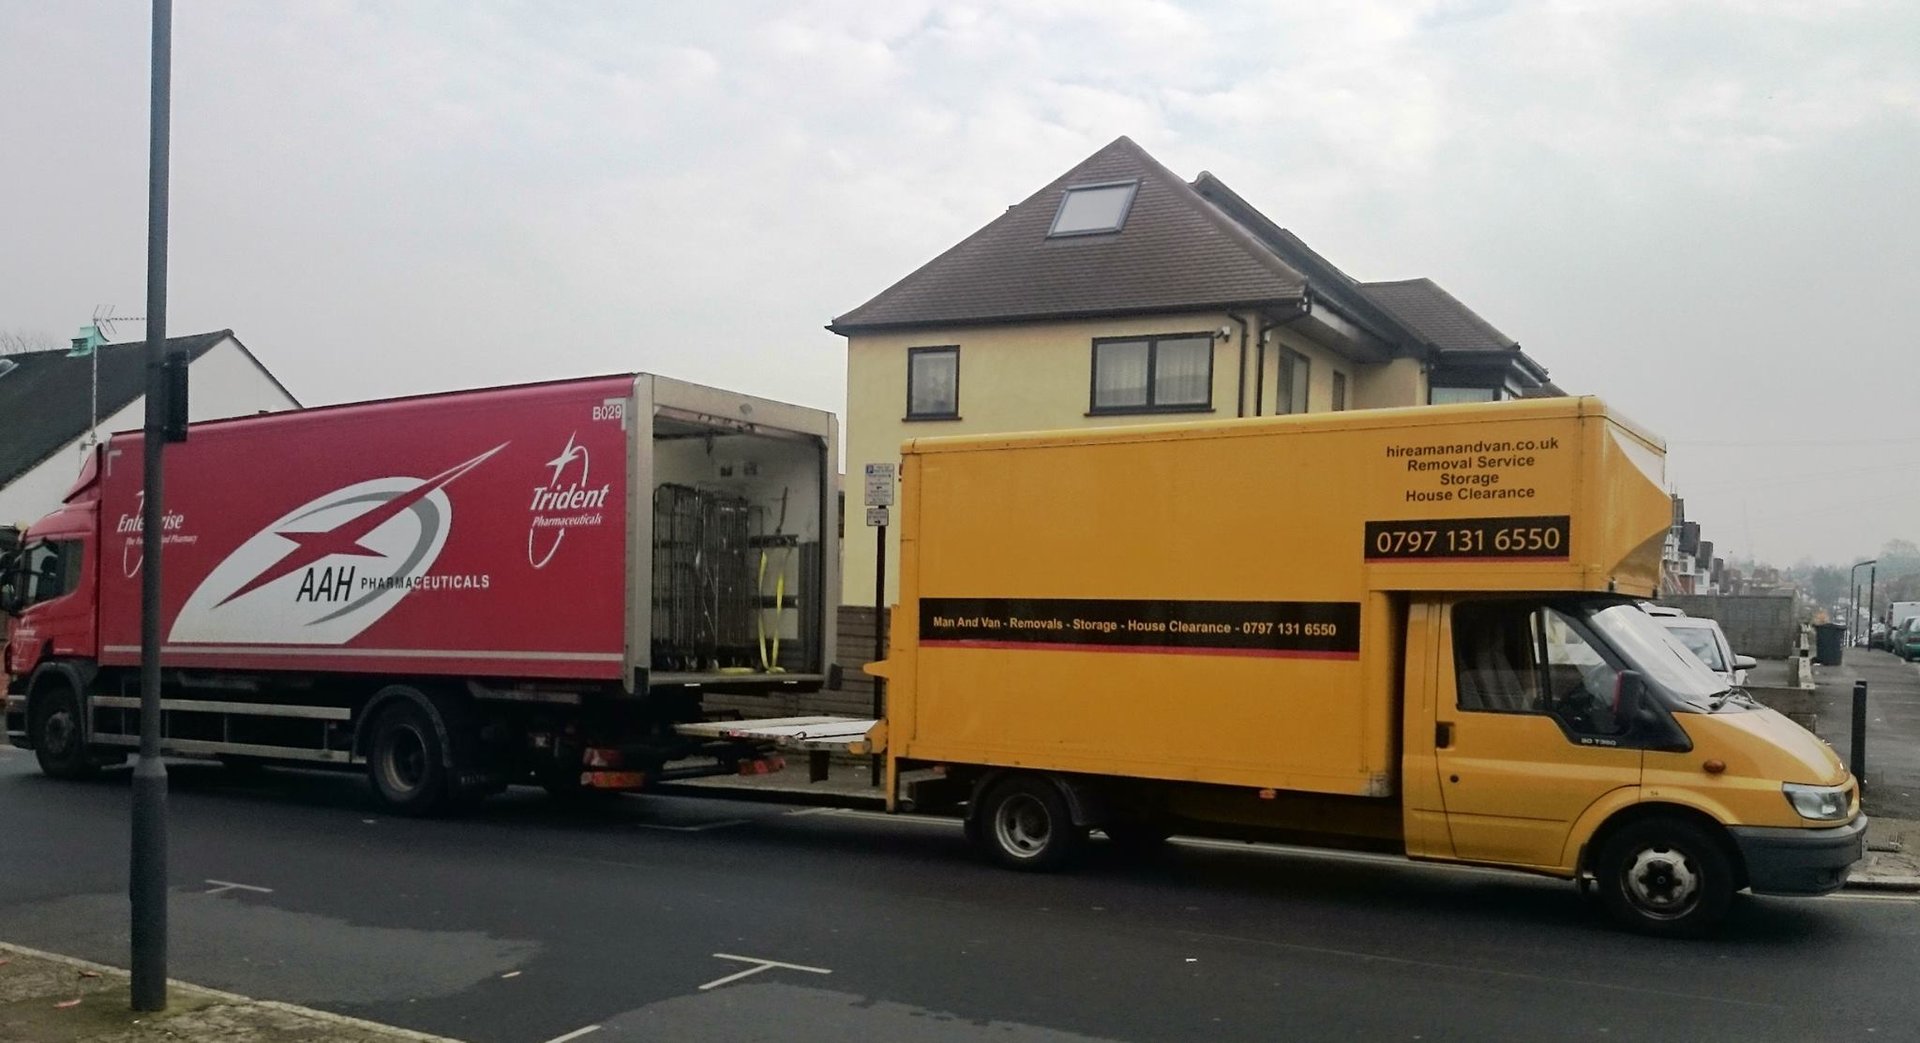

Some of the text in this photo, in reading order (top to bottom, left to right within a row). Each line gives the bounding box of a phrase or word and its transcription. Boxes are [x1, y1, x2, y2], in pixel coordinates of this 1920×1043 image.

[592, 405, 622, 420] B029
[1386, 437, 1559, 457] hireamanandvan.co.uk
[1407, 454, 1535, 472] Removal Service
[1440, 473, 1499, 487] Storage
[530, 482, 609, 510] Trident
[1406, 487, 1535, 502] House Clearance
[532, 513, 603, 528] Pharmaceuticals
[1377, 527, 1560, 553] 0797 131 6550
[296, 566, 489, 602] AAH PHARMACEUTICALS
[933, 616, 955, 628] Man
[957, 617, 978, 628] And
[981, 617, 1001, 629] Van
[1010, 617, 1063, 630] Removals
[1073, 619, 1117, 632] Storage
[1129, 620, 1166, 632] House
[1169, 621, 1231, 634] Clearance
[1243, 622, 1272, 635] 0797
[1278, 623, 1300, 635] 131
[1304, 623, 1337, 636] 6550
